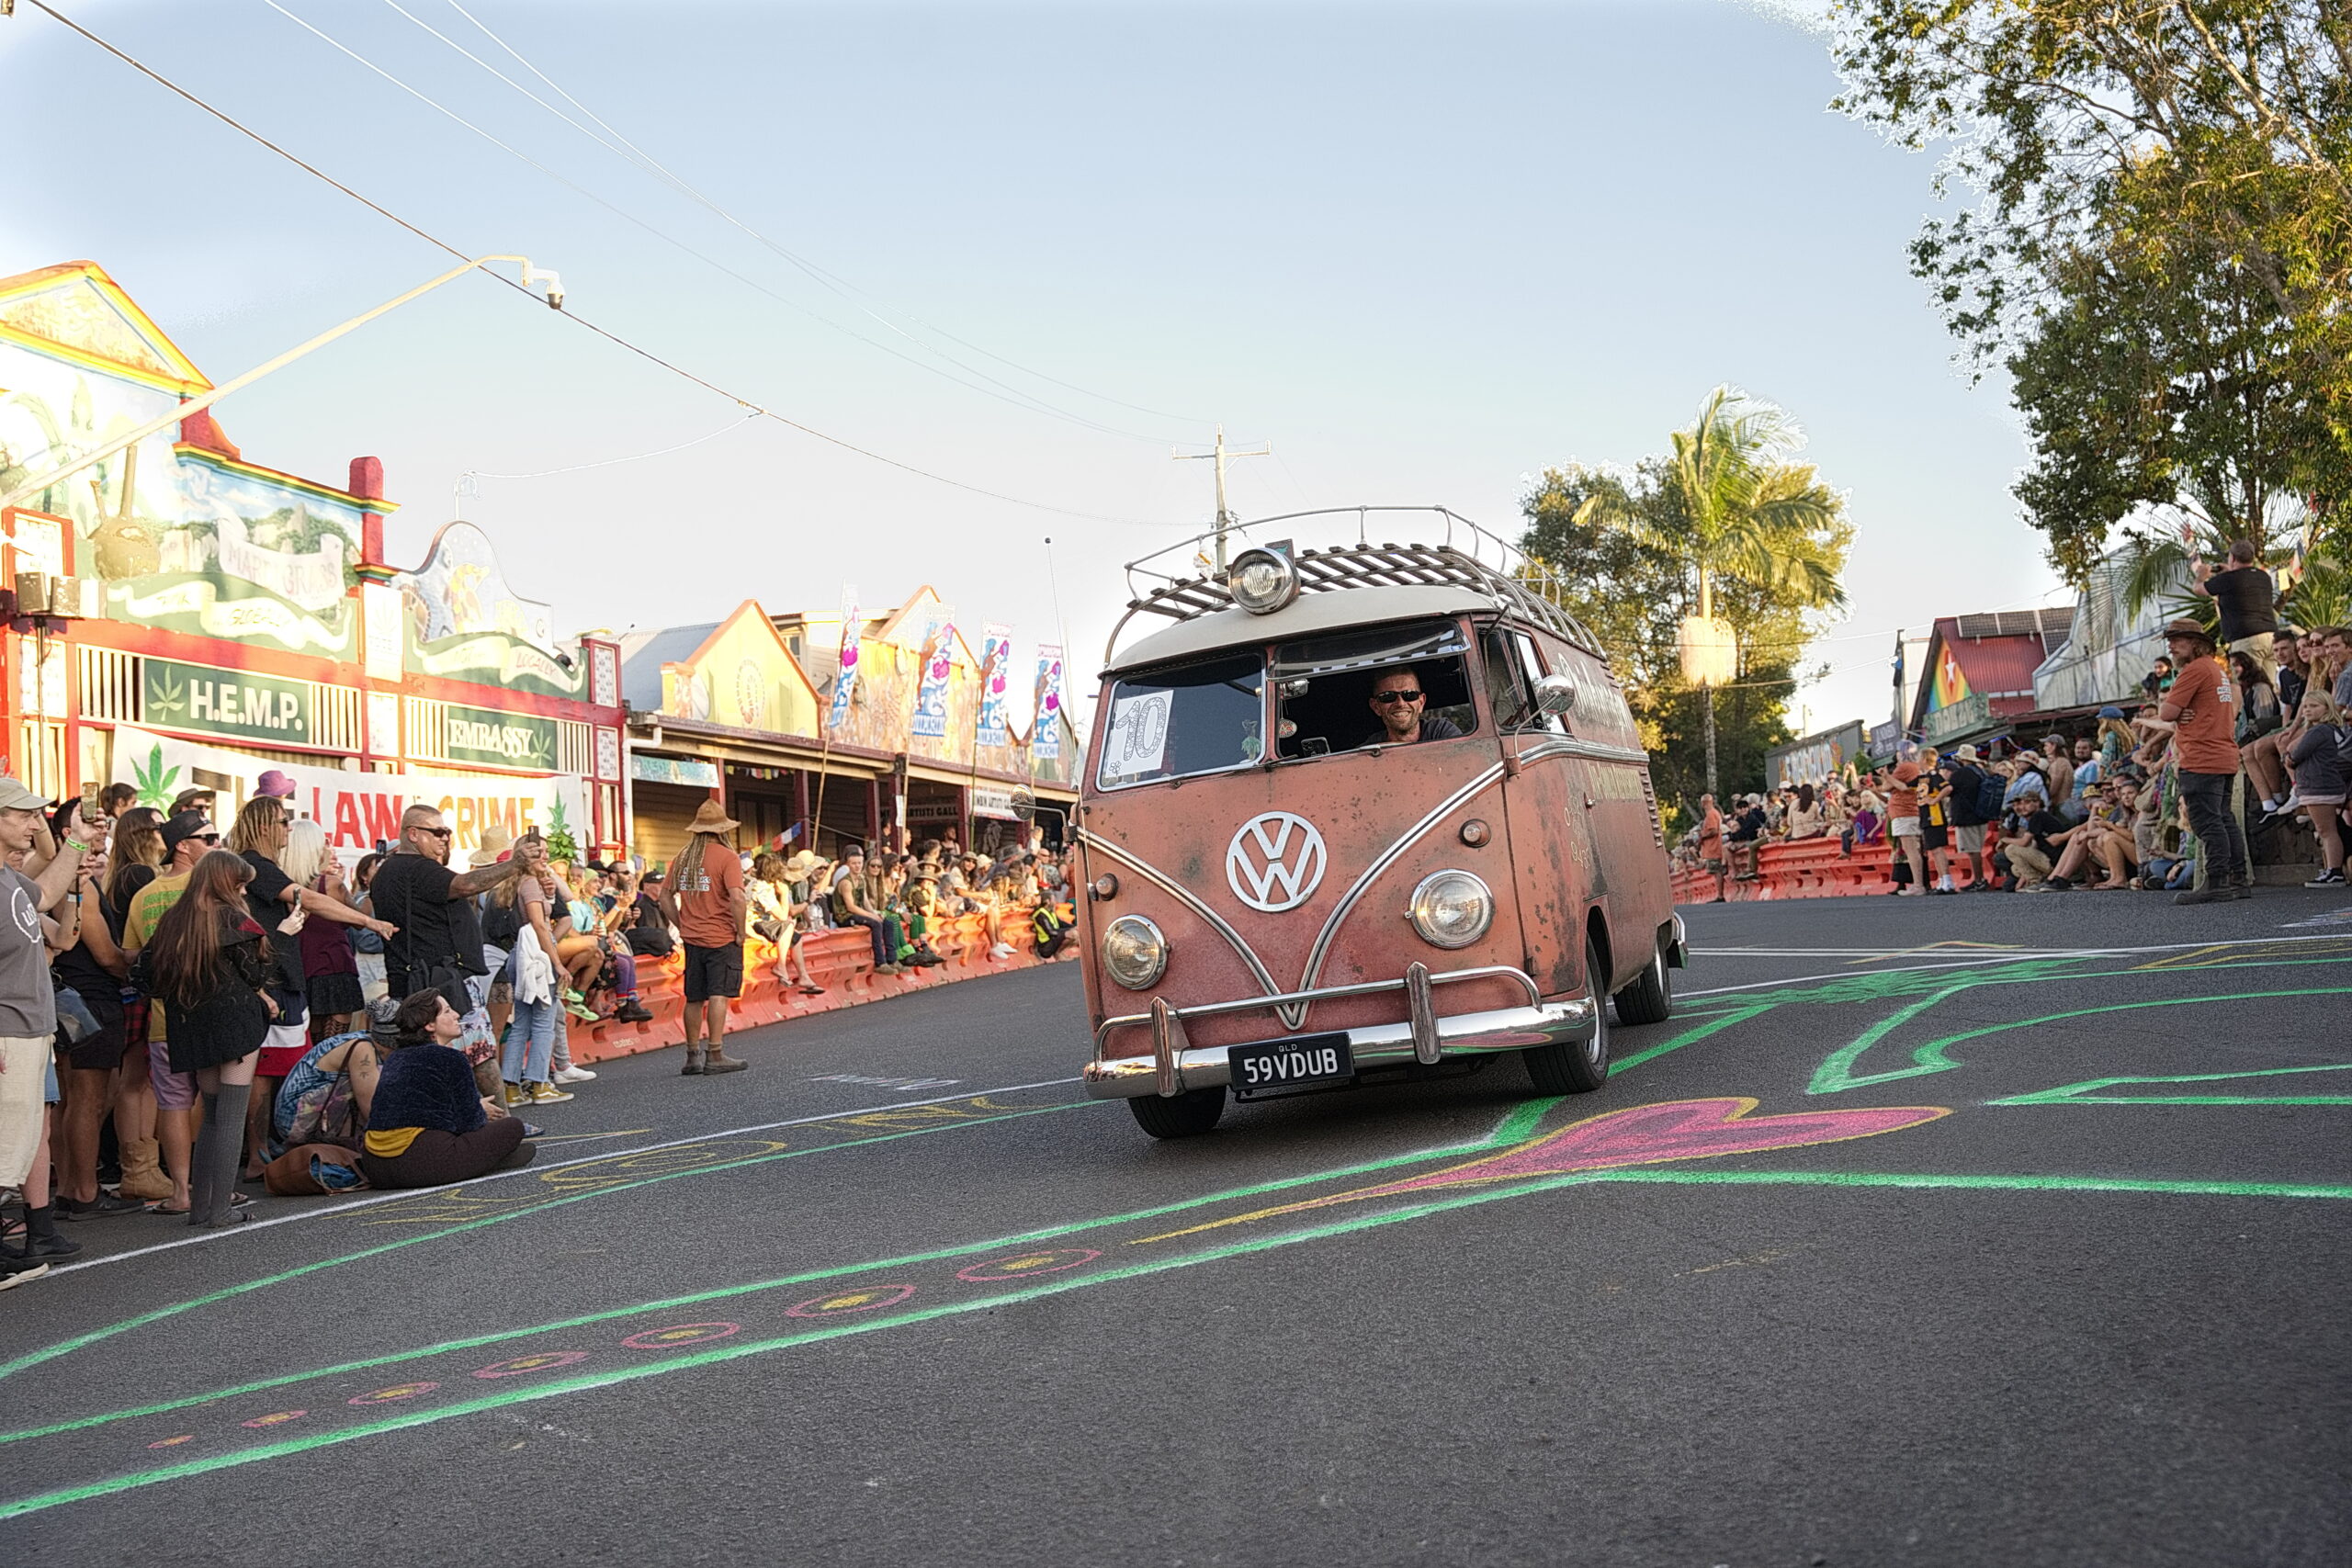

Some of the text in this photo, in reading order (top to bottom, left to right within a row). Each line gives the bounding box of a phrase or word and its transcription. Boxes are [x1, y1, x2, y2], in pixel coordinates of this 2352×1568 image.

[515, 652, 557, 676] LOCALLY
[190, 679, 303, 731] H.E.M.P.
[448, 719, 533, 758] EMBASSY
[1115, 696, 1167, 761] 10
[312, 786, 403, 850] LAW
[1243, 1047, 1339, 1084] 59VDUB
[1278, 1043, 1297, 1054] QLD
